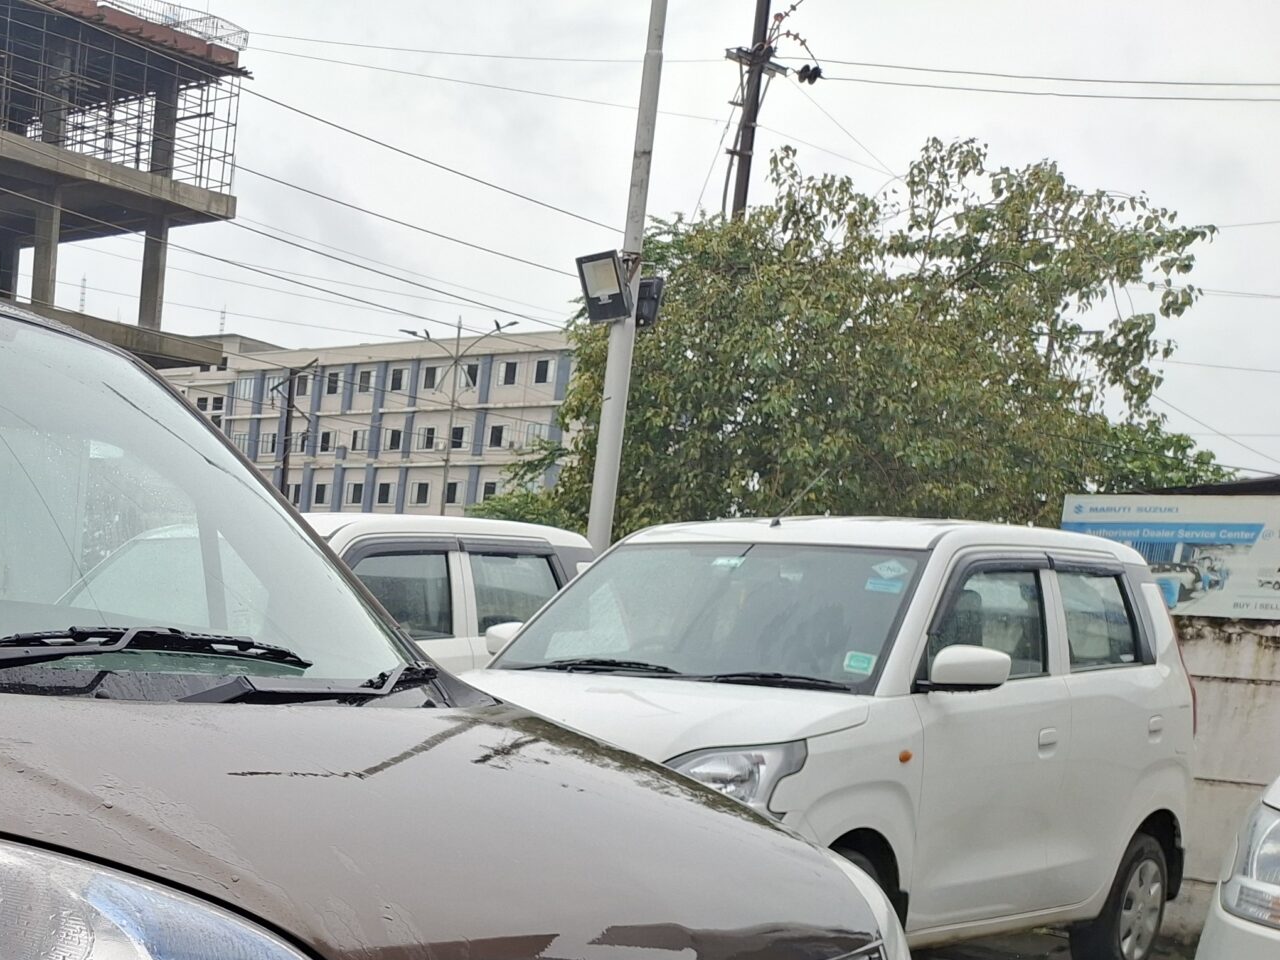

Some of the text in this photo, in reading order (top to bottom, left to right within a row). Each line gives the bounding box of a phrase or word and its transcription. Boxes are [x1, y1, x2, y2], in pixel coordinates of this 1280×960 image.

[1089, 505, 1179, 513] MARUTI SUZUKI
[1086, 528, 1140, 538] Authorised
[1143, 528, 1174, 538] Dealer
[1177, 528, 1216, 539] Service
[1219, 529, 1256, 539] Center
[1233, 601, 1250, 609] BUY
